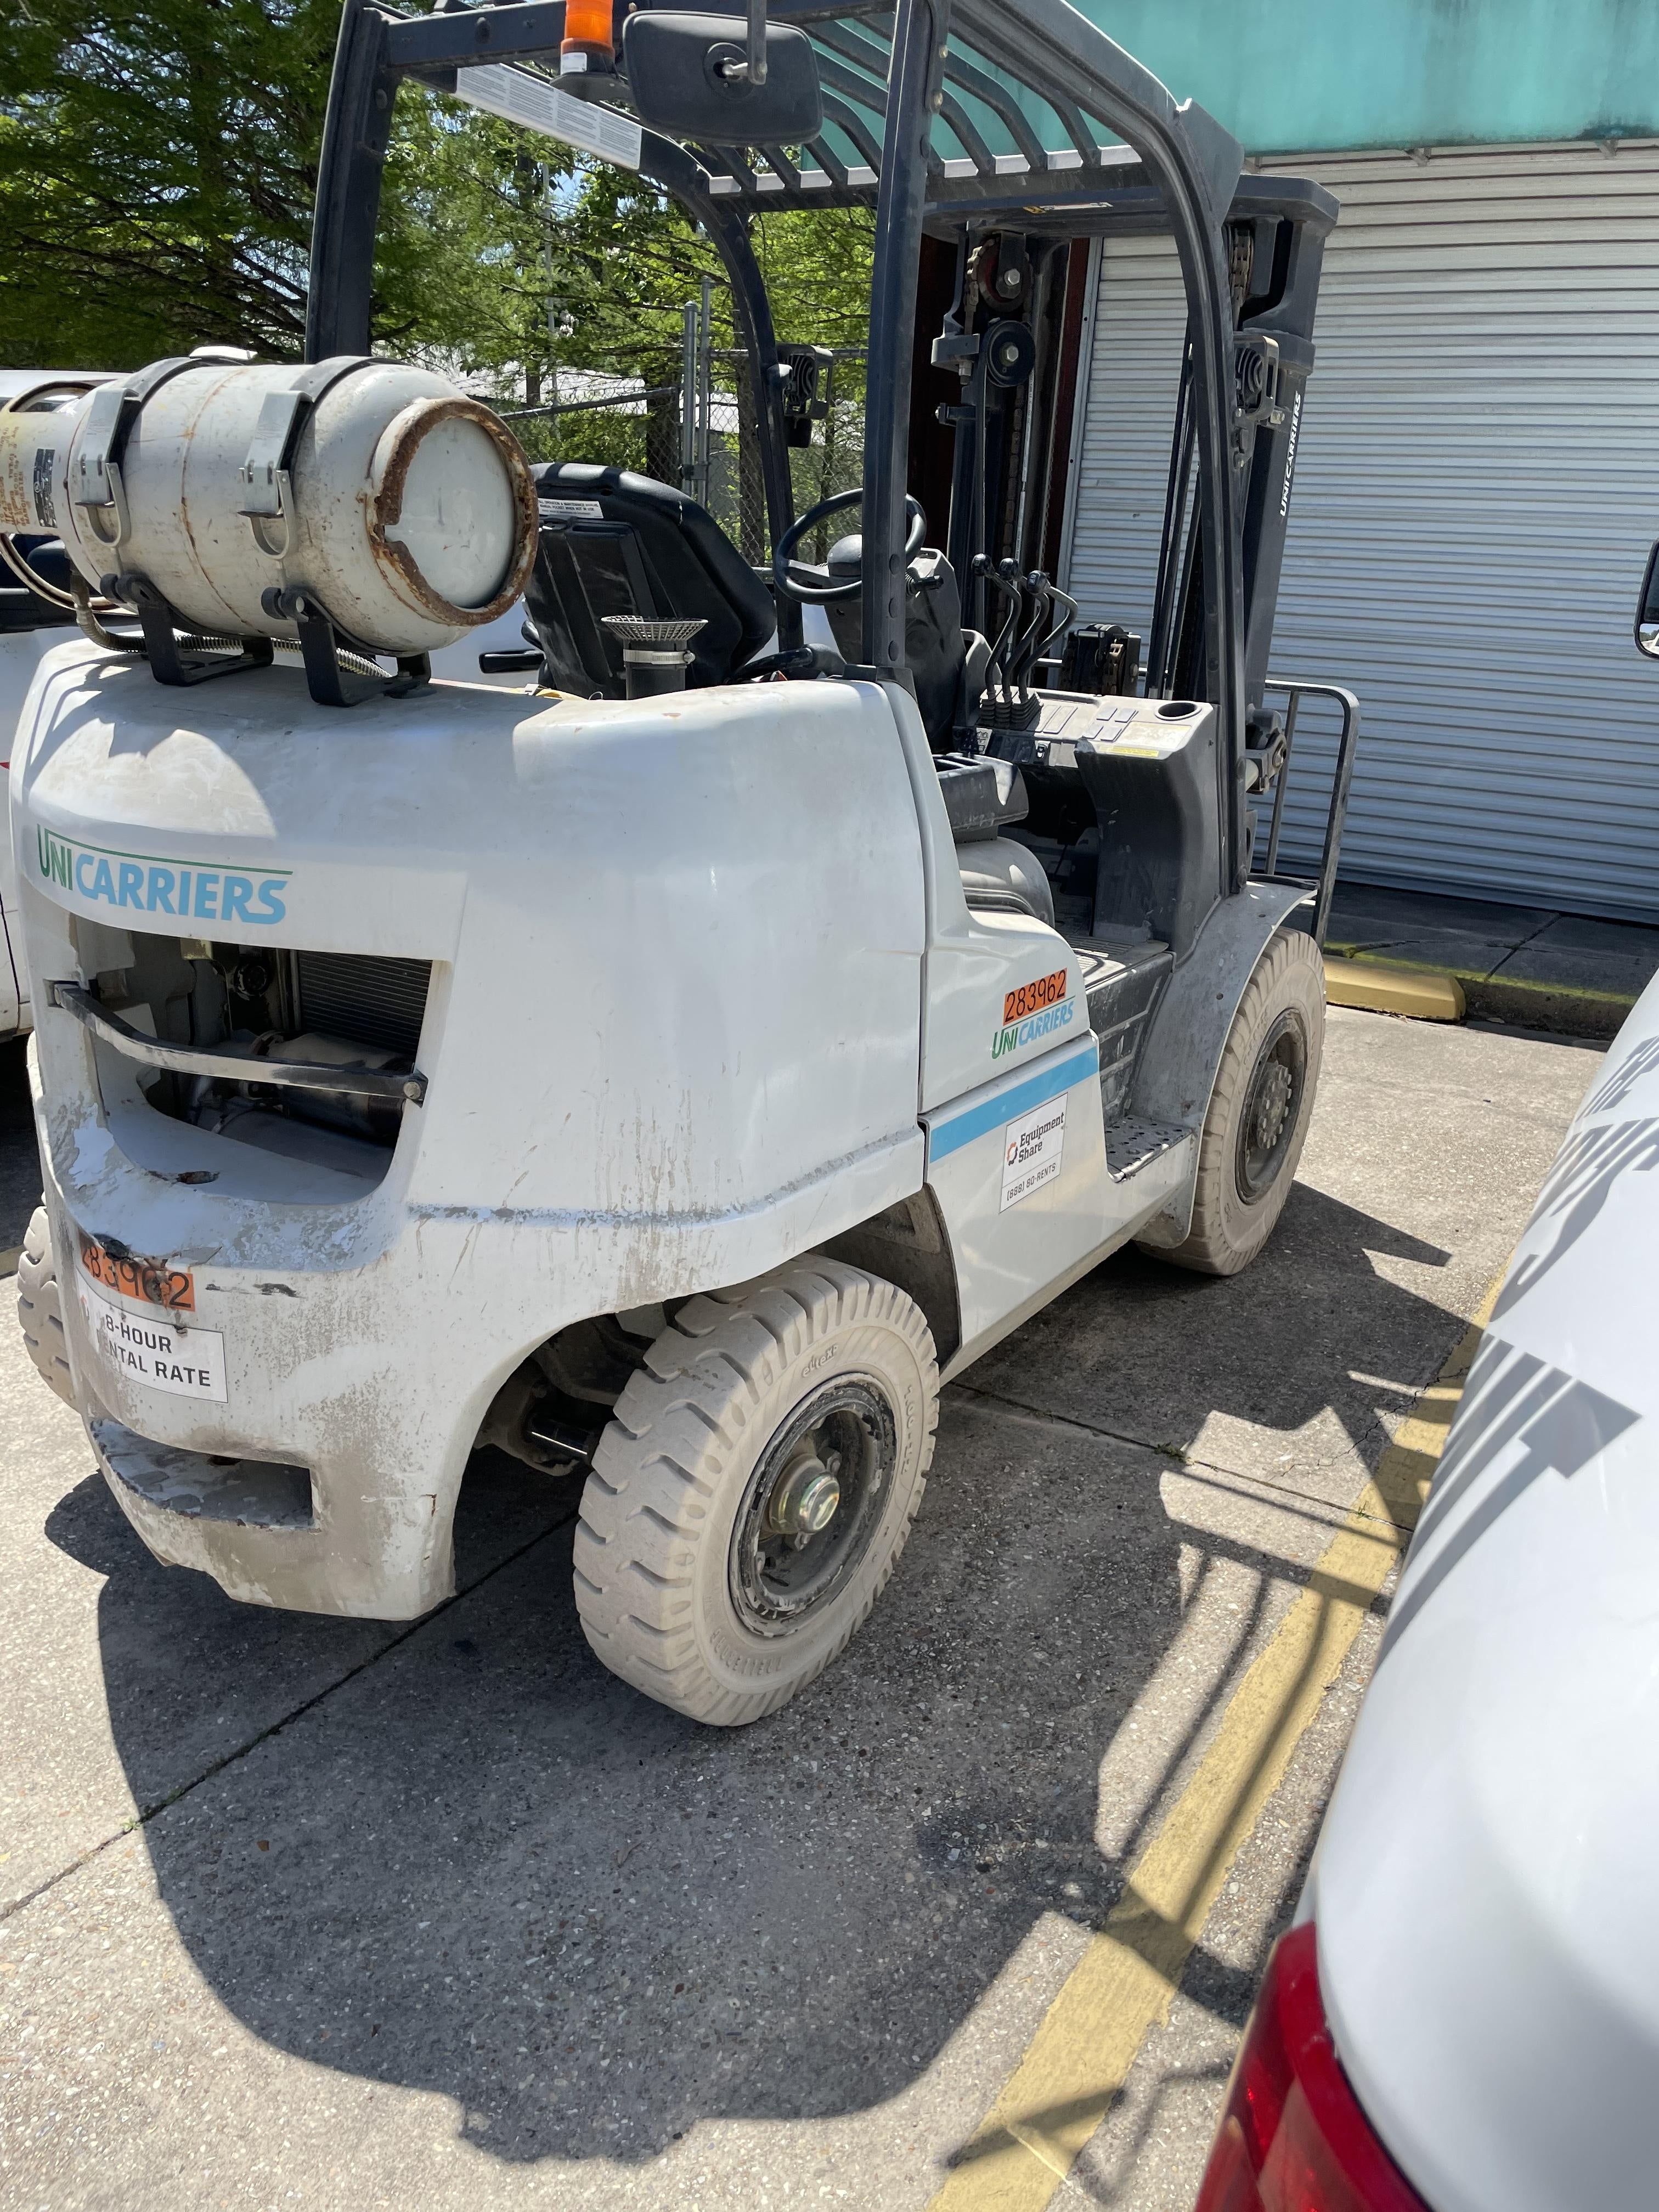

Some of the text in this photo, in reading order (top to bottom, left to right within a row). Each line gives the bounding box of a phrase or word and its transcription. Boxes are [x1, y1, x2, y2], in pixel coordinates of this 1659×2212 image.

[1280, 391, 1301, 516] UNICARRIERS
[37, 823, 289, 924] UNICARRIERS
[1005, 969, 1066, 1023] 283962
[992, 998, 1075, 1059] UNICARRIERS
[1018, 1141, 1043, 1164] Share
[1019, 1112, 1064, 1147] Equipment
[1007, 1163, 1056, 1201] (888) 80-RENTS
[109, 1340, 211, 1387] NTAL RATE
